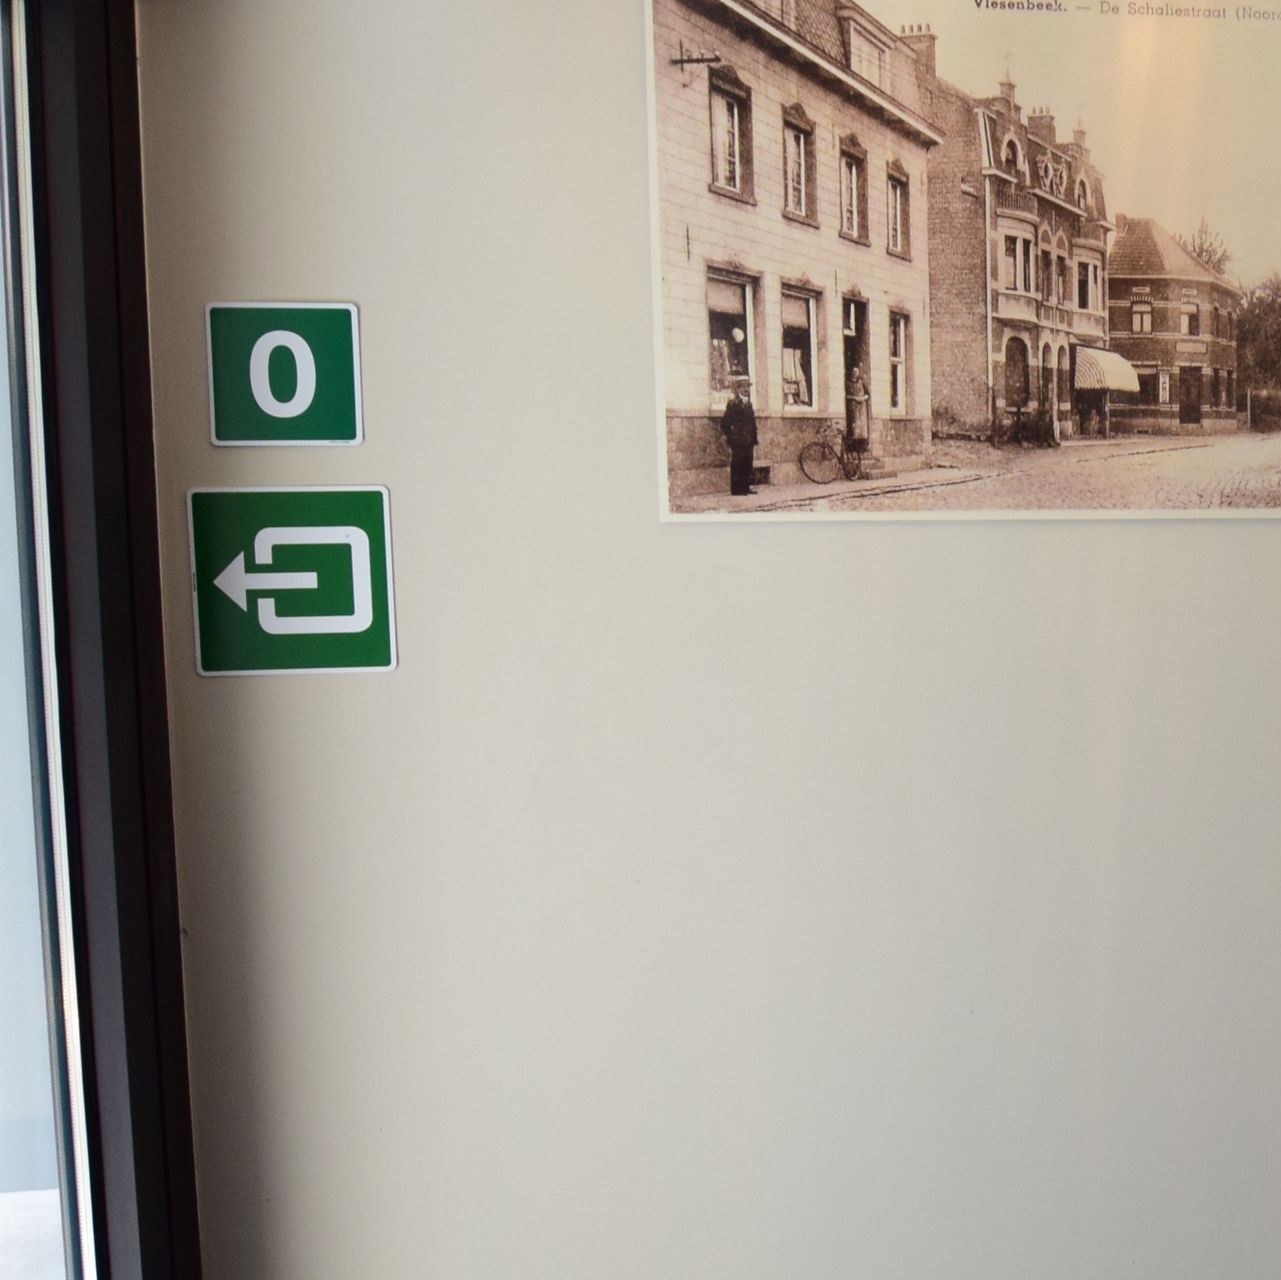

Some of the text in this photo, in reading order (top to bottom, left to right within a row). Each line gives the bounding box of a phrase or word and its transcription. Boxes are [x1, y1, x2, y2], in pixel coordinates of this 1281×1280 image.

[1100, 0, 1120, 15] De
[1128, 2, 1227, 19] Schaliestraat
[249, 330, 316, 418] 0
